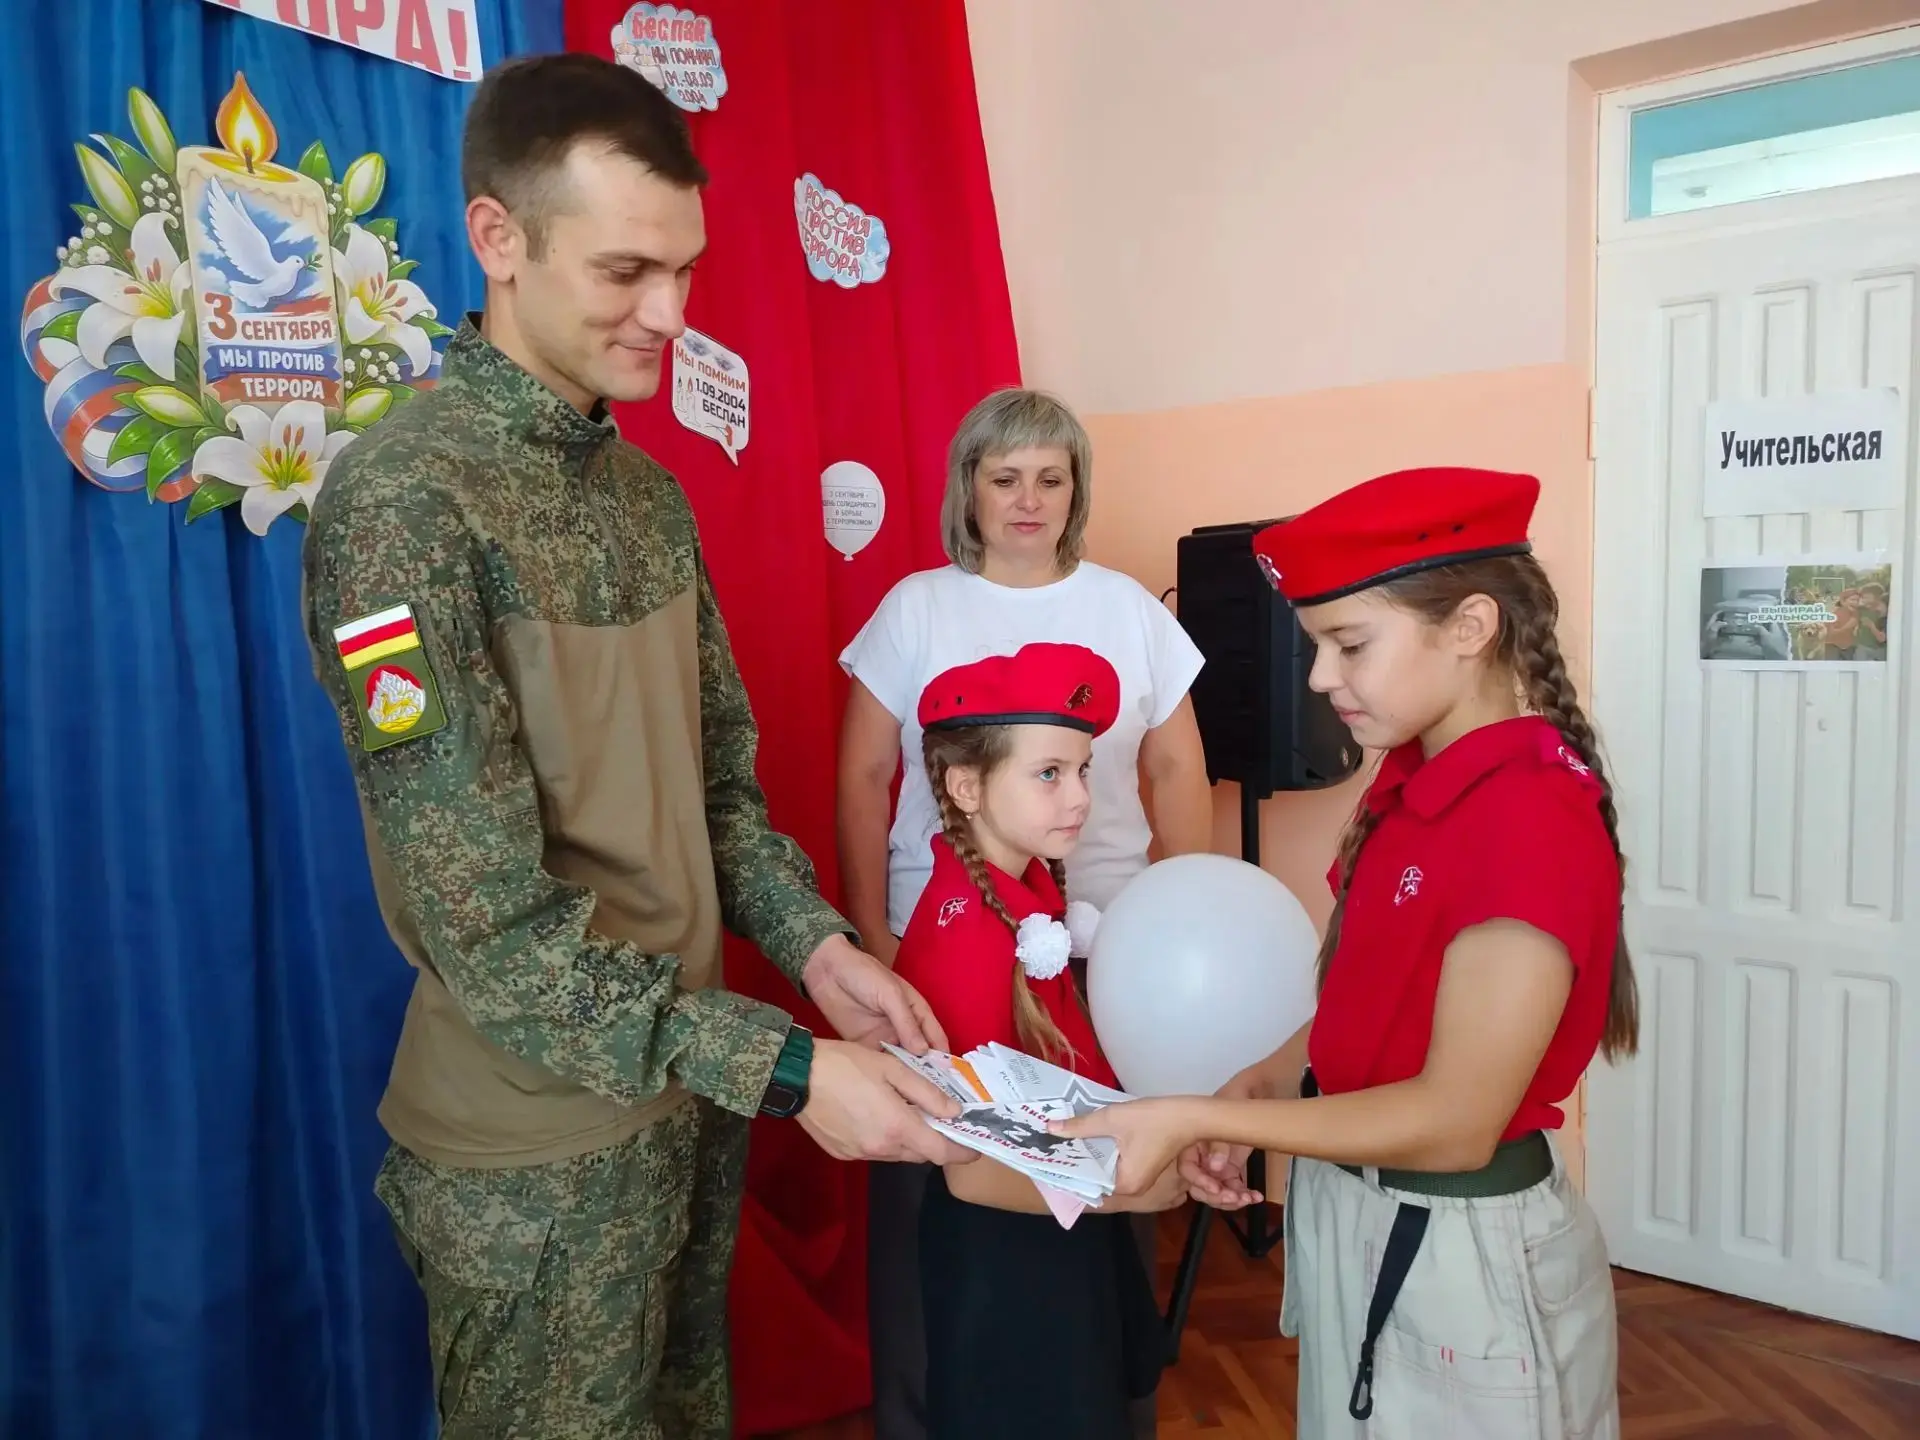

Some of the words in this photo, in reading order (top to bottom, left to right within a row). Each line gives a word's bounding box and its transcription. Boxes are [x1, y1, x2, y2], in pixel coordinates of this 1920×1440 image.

[677, 89, 708, 105] 2004
[805, 183, 871, 238] РОССИЯ
[805, 206, 866, 256] ПРОТИВ
[204, 292, 237, 341] 3
[241, 319, 333, 341] СЕНТЯБРЯ
[218, 348, 253, 369] МЫ
[258, 350, 325, 372] ПРОТИВ
[240, 377, 325, 400] ТЕРРОРА
[695, 377, 746, 411] 1.09.2004
[702, 398, 746, 428] БЕСЛАН
[1720, 429, 1883, 470] Учительская
[1750, 614, 1835, 622] РЕАЛЬНОСТЬ
[1760, 603, 1824, 614] ВЫБИРАЙ
